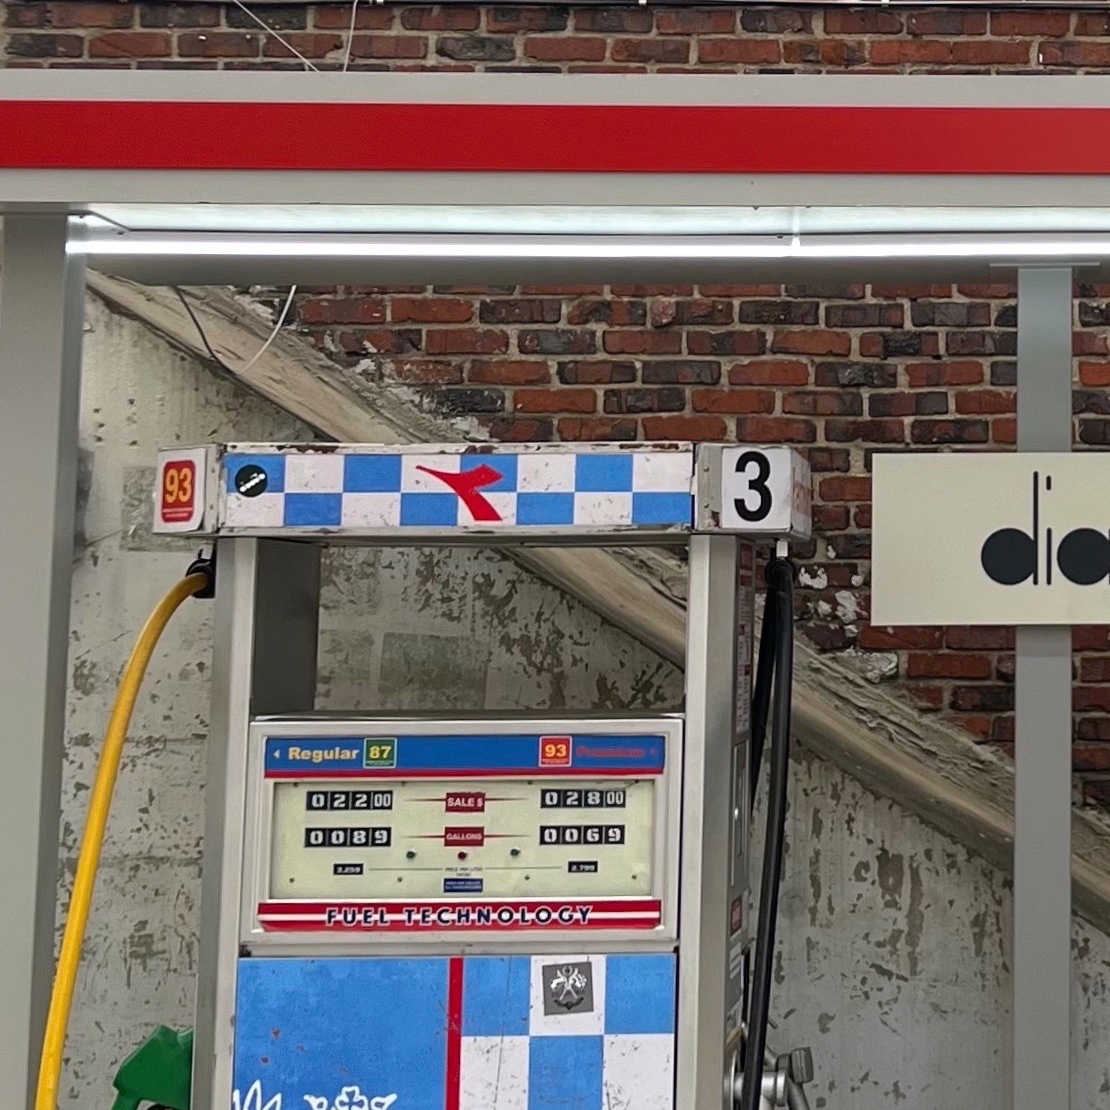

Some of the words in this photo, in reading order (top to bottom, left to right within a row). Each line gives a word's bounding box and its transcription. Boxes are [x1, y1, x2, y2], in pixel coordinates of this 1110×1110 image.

[165, 467, 192, 503] 93
[734, 450, 773, 523] 3
[288, 746, 360, 763] Regular
[368, 745, 392, 759] 87
[544, 743, 567, 758] 93
[447, 797, 475, 807] SALE
[446, 832, 482, 841] GALLONS
[325, 907, 390, 926] FUEL
[403, 905, 594, 926] TECHNOLOGY
